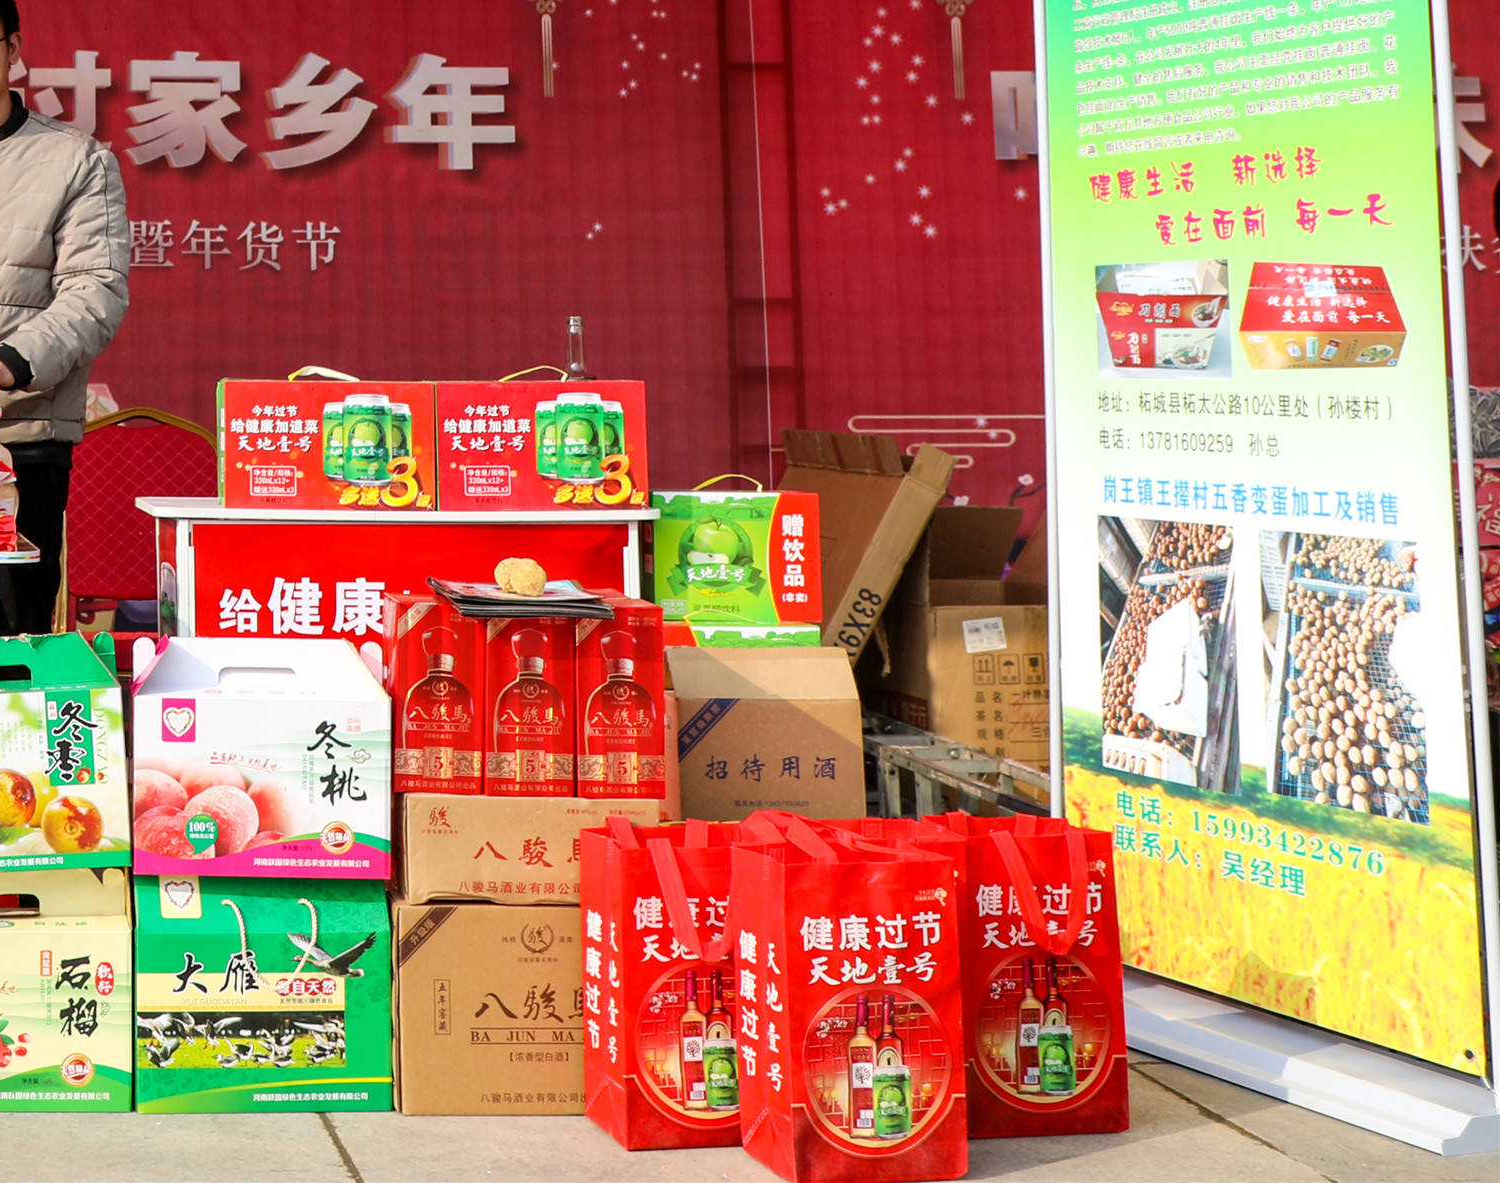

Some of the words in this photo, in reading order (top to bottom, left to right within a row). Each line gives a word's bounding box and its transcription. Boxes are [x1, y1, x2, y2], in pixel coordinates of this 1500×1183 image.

[1089, 160, 1196, 204] 健康生活
[1231, 146, 1322, 187] 新选择
[1295, 193, 1394, 234] 每一天
[128, 219, 342, 272] 暨年货节
[230, 419, 319, 434] 给健康加道菜
[251, 405, 299, 418] 今年过节
[443, 418, 532, 434] 给健康加道菜
[464, 404, 511, 417] 今年过节
[237, 435, 313, 453] 天地壹号
[451, 435, 526, 452] 天地壹号
[1099, 426, 1234, 454] 电话：13781609259
[1249, 432, 1281, 458] 孙总
[781, 512, 806, 588] 赠饮品
[686, 564, 746, 583] 天地壹号
[306, 720, 368, 807] 冬桃
[433, 755, 444, 771] 5
[525, 759, 536, 773] 5
[617, 760, 628, 776] 5
[704, 753, 837, 783] 招待用酒
[188, 821, 216, 833] 100%
[1116, 789, 1384, 877] 电话：15993422876
[1113, 824, 1306, 898] 联系人：吴经理
[800, 911, 943, 952] 健康过节
[173, 949, 260, 995] 大雁
[586, 908, 603, 1050] 健康过节
[808, 952, 939, 987] 天地壹号
[55, 955, 99, 1038] 石榴
[739, 928, 758, 1079] 健康过节
[765, 942, 784, 1094] 天地壹号
[470, 1030, 492, 1043] BA
[506, 1030, 537, 1043] JUN
[552, 1030, 576, 1043] MA
